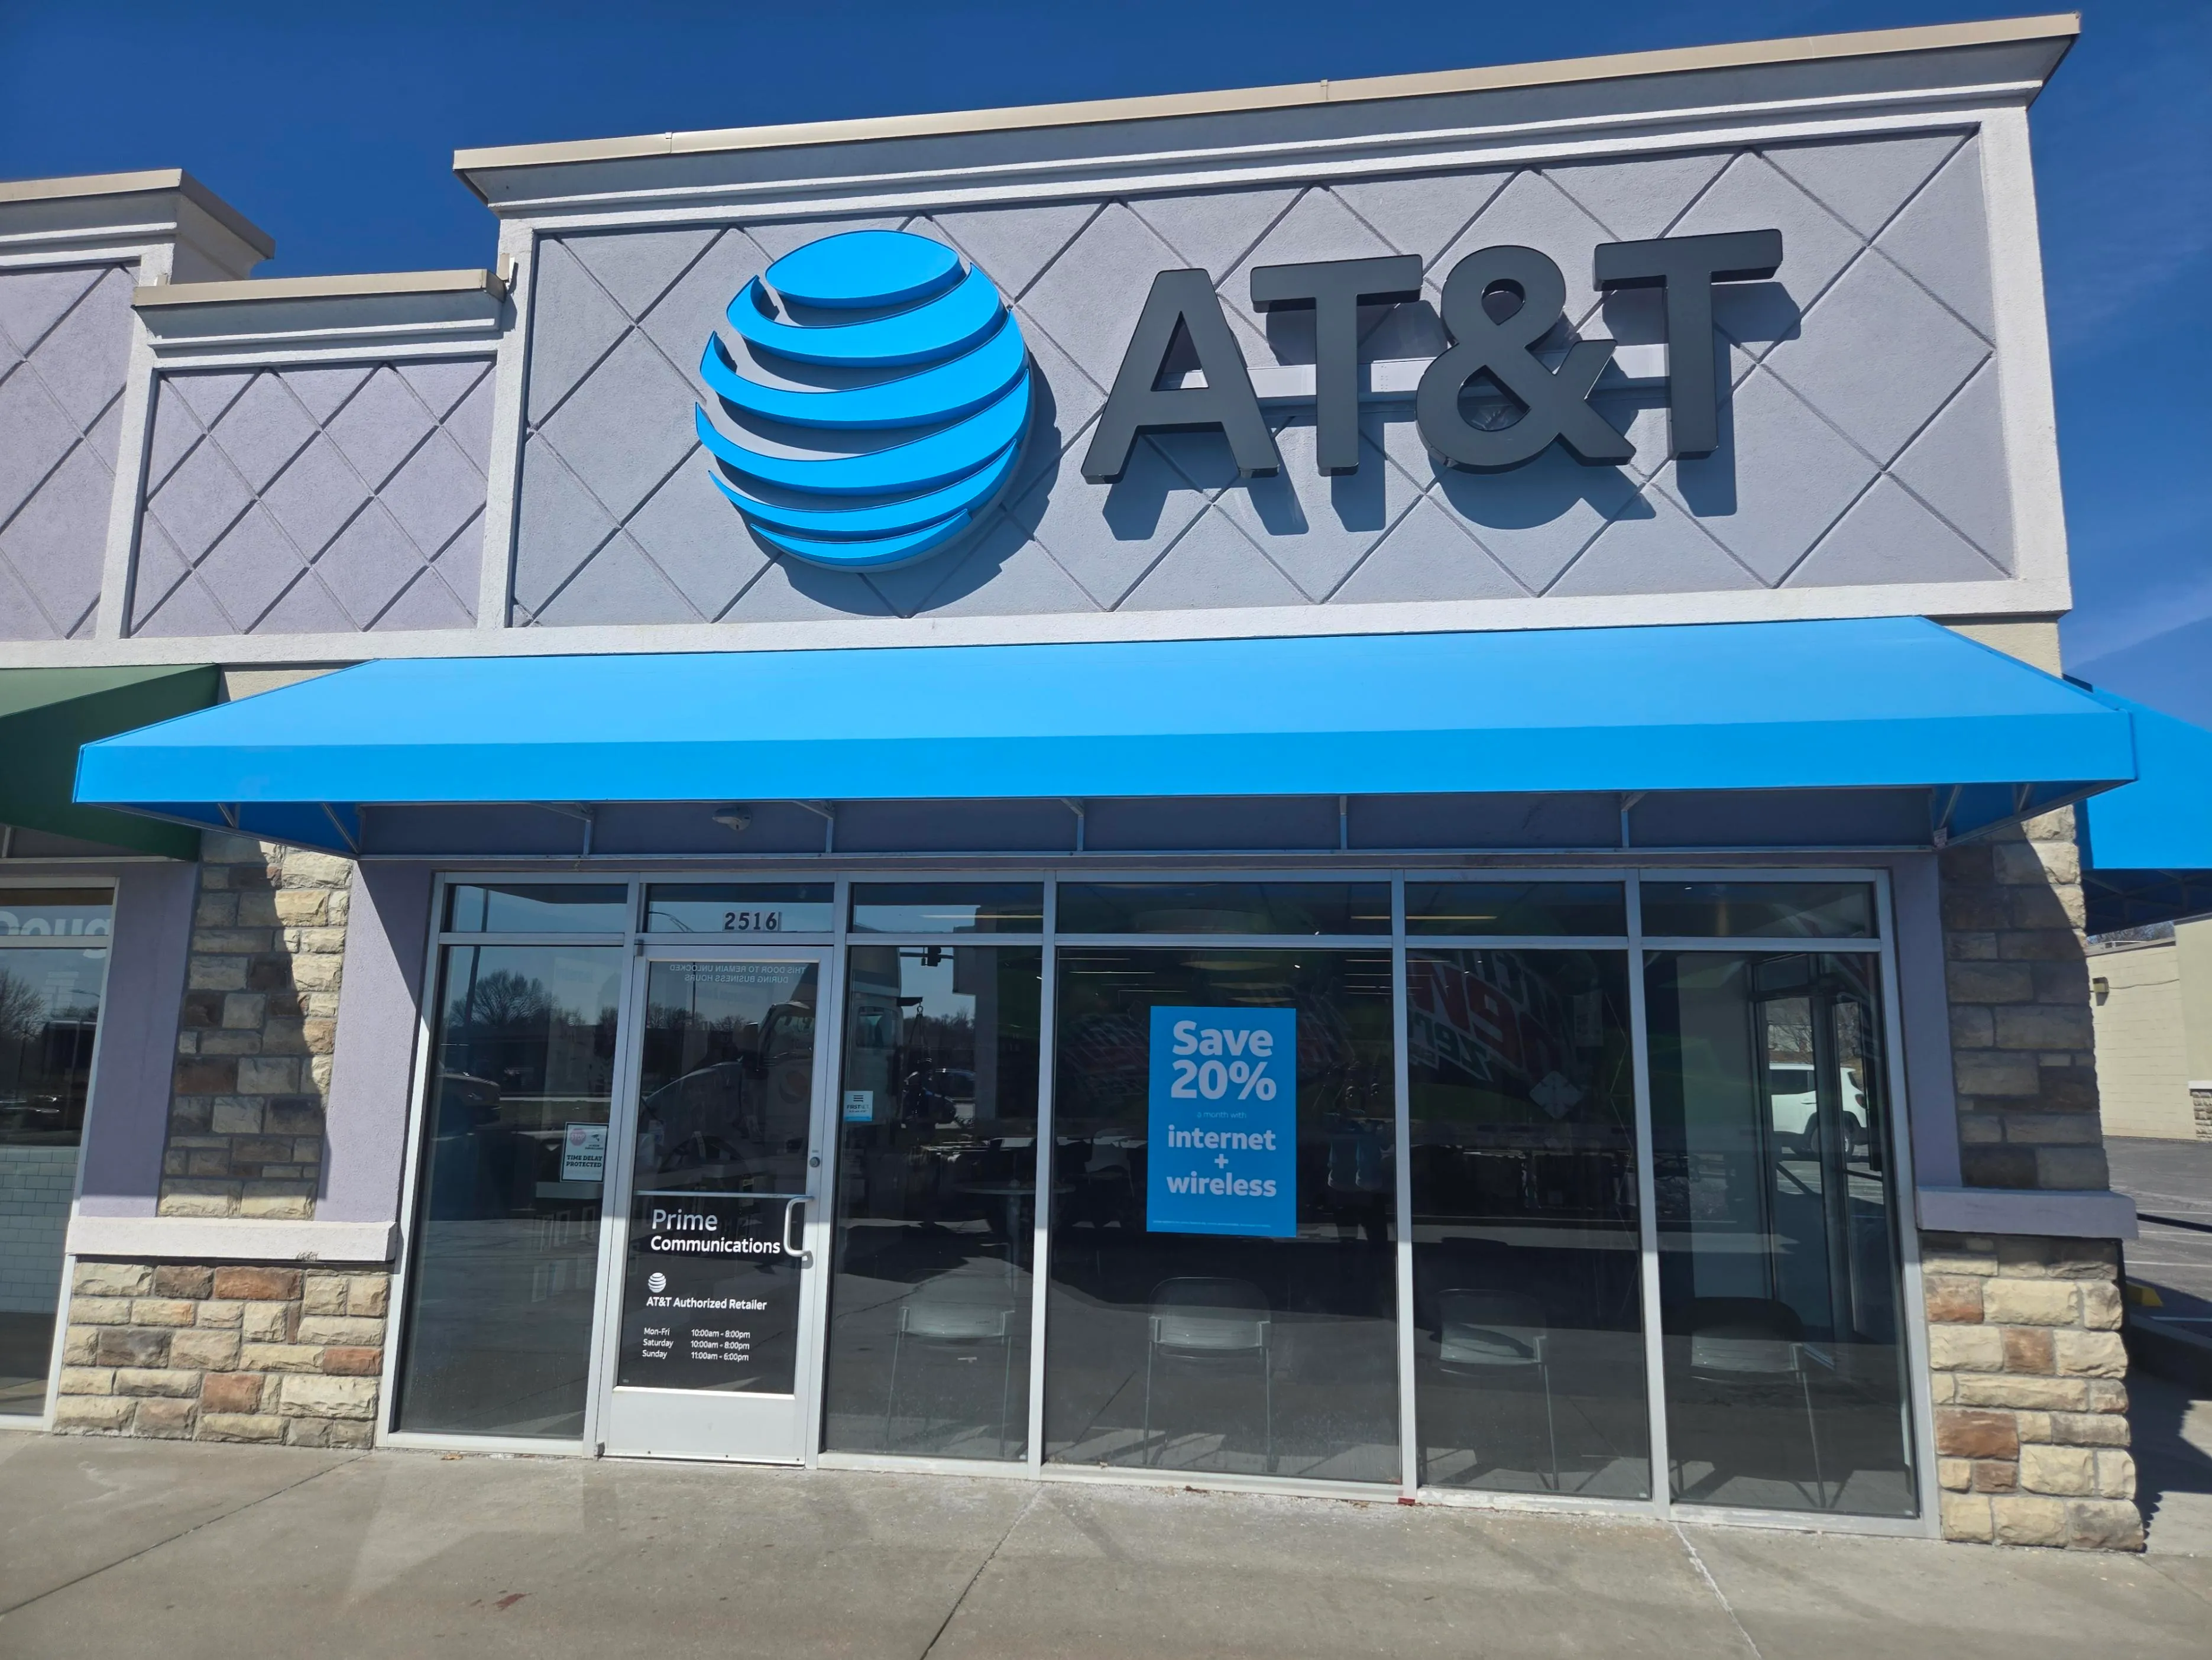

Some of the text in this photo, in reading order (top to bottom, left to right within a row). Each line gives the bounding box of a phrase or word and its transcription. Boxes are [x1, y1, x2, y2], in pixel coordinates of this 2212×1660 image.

[1081, 229, 1783, 484] AT&T
[724, 912, 777, 930] 2516
[1172, 1020, 1274, 1057] Save
[1171, 1059, 1277, 1101] 20%
[1168, 1124, 1276, 1150] internet
[1214, 1154, 1229, 1169] +
[1166, 1170, 1277, 1197] wireless
[652, 1209, 717, 1231] Prime
[650, 1235, 780, 1254] Communications
[646, 1296, 767, 1310] AT&T Authorized Retailer
[644, 1327, 670, 1336] Mon-Fri
[691, 1329, 719, 1337] 10:00am
[725, 1330, 750, 1339] 8:00pm
[643, 1338, 674, 1348] Saturday
[691, 1340, 718, 1348] 10:00am
[724, 1341, 750, 1351] 8:00pm
[642, 1350, 668, 1359] Sunday
[691, 1351, 718, 1360] 11:00am
[724, 1352, 749, 1362] 6:00pm
